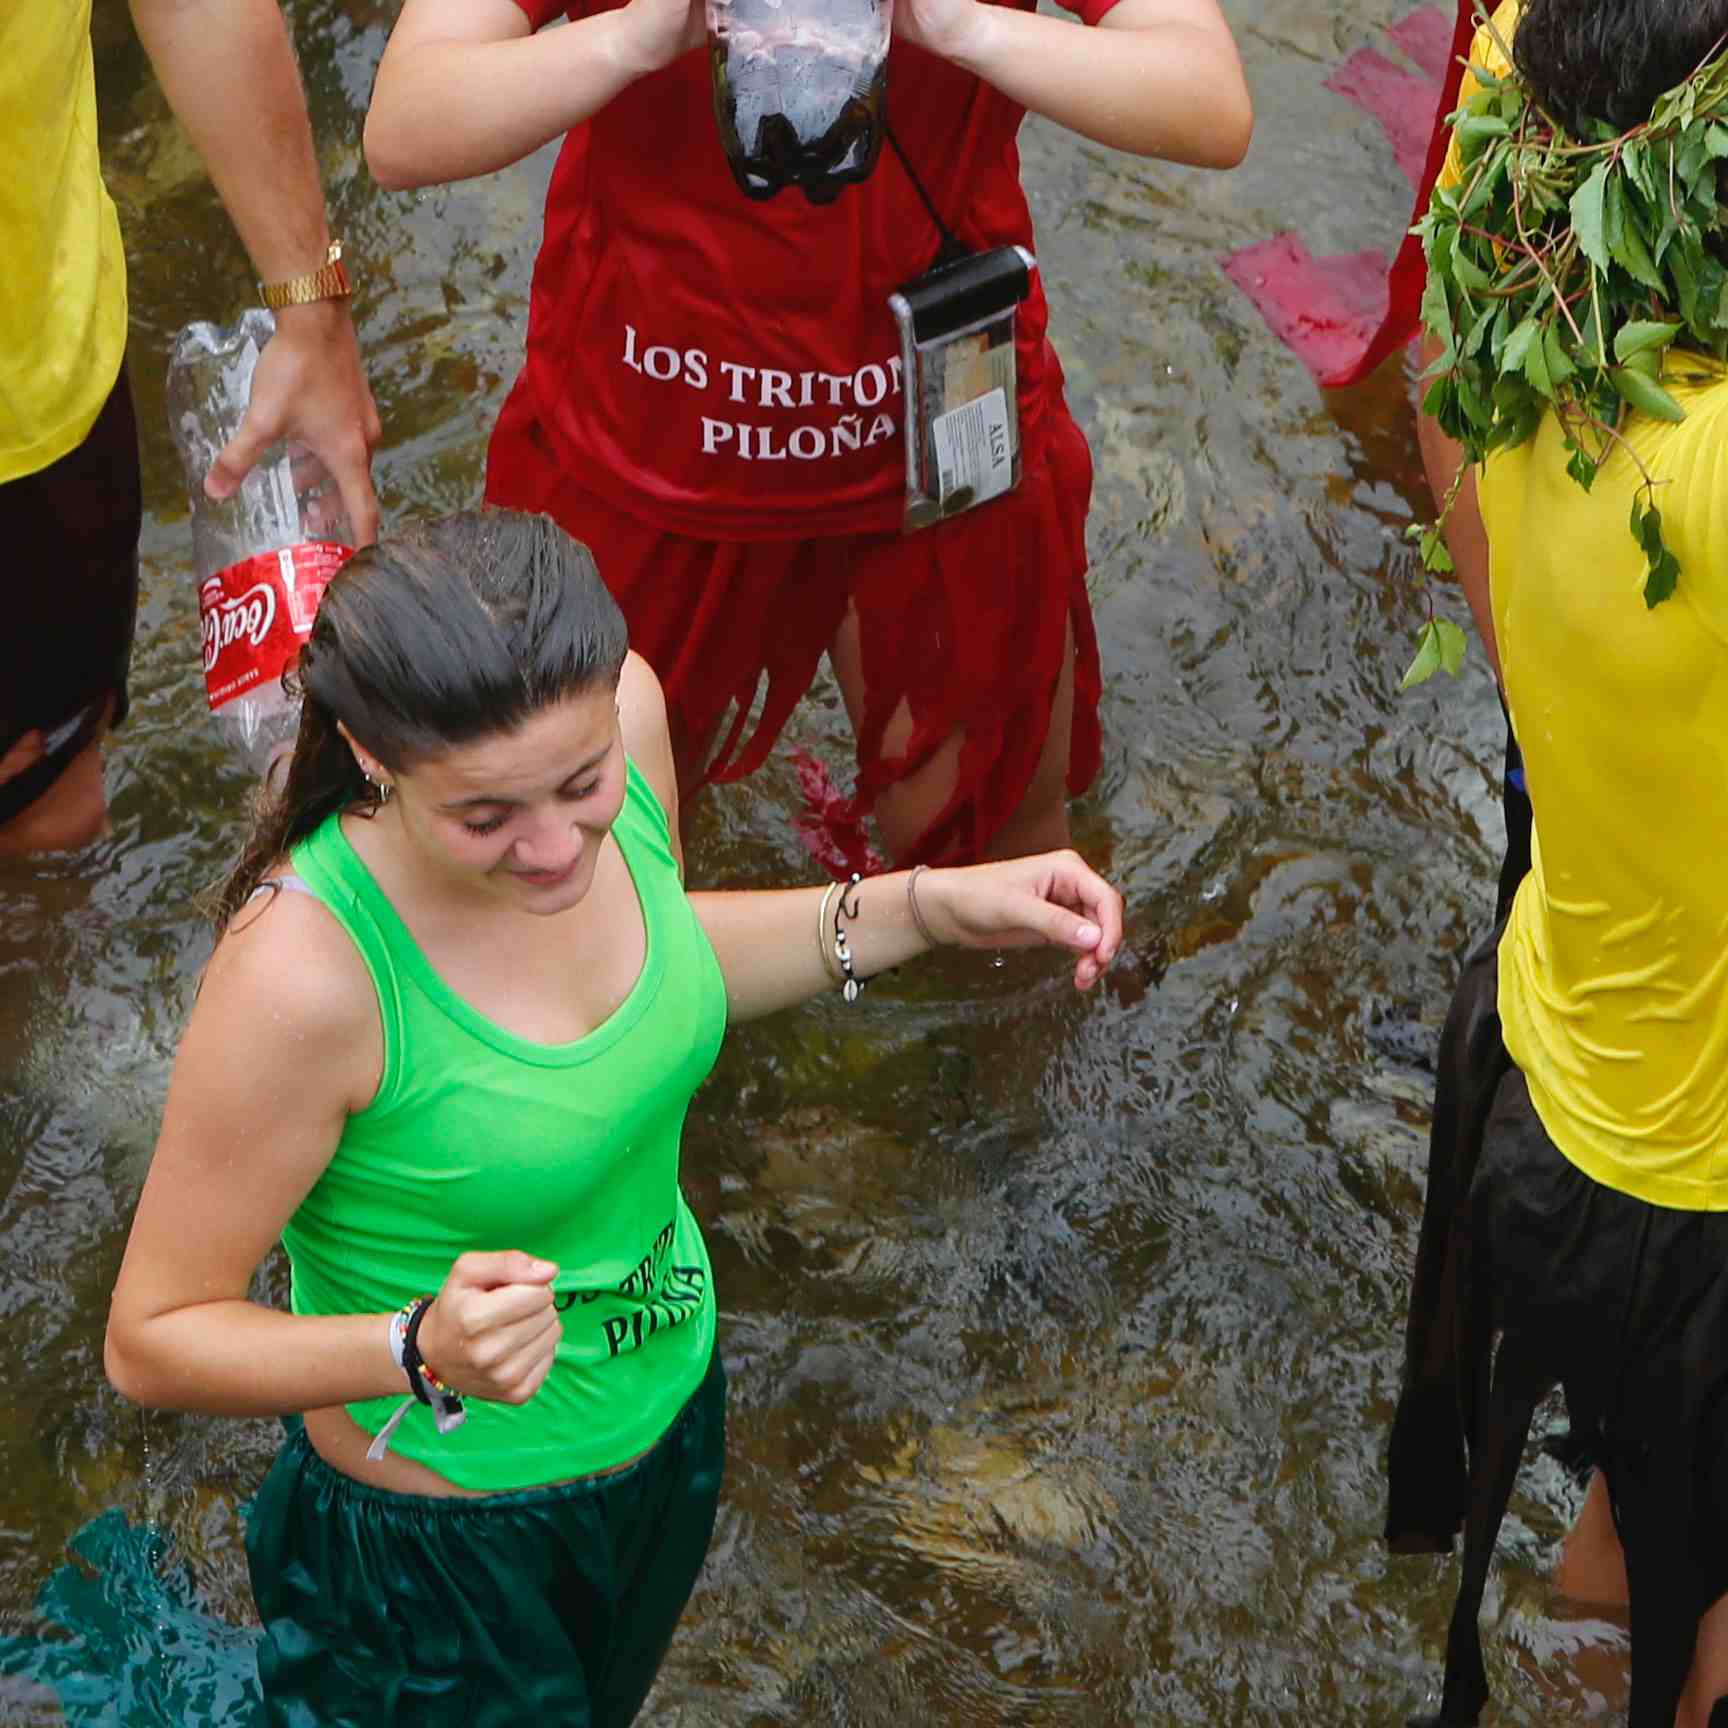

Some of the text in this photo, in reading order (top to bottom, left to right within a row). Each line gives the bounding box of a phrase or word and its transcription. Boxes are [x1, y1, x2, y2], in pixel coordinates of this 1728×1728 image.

[623, 323, 709, 390] LOS
[700, 413, 896, 460] PILOÑA
[988, 422, 1006, 470] ALSA
